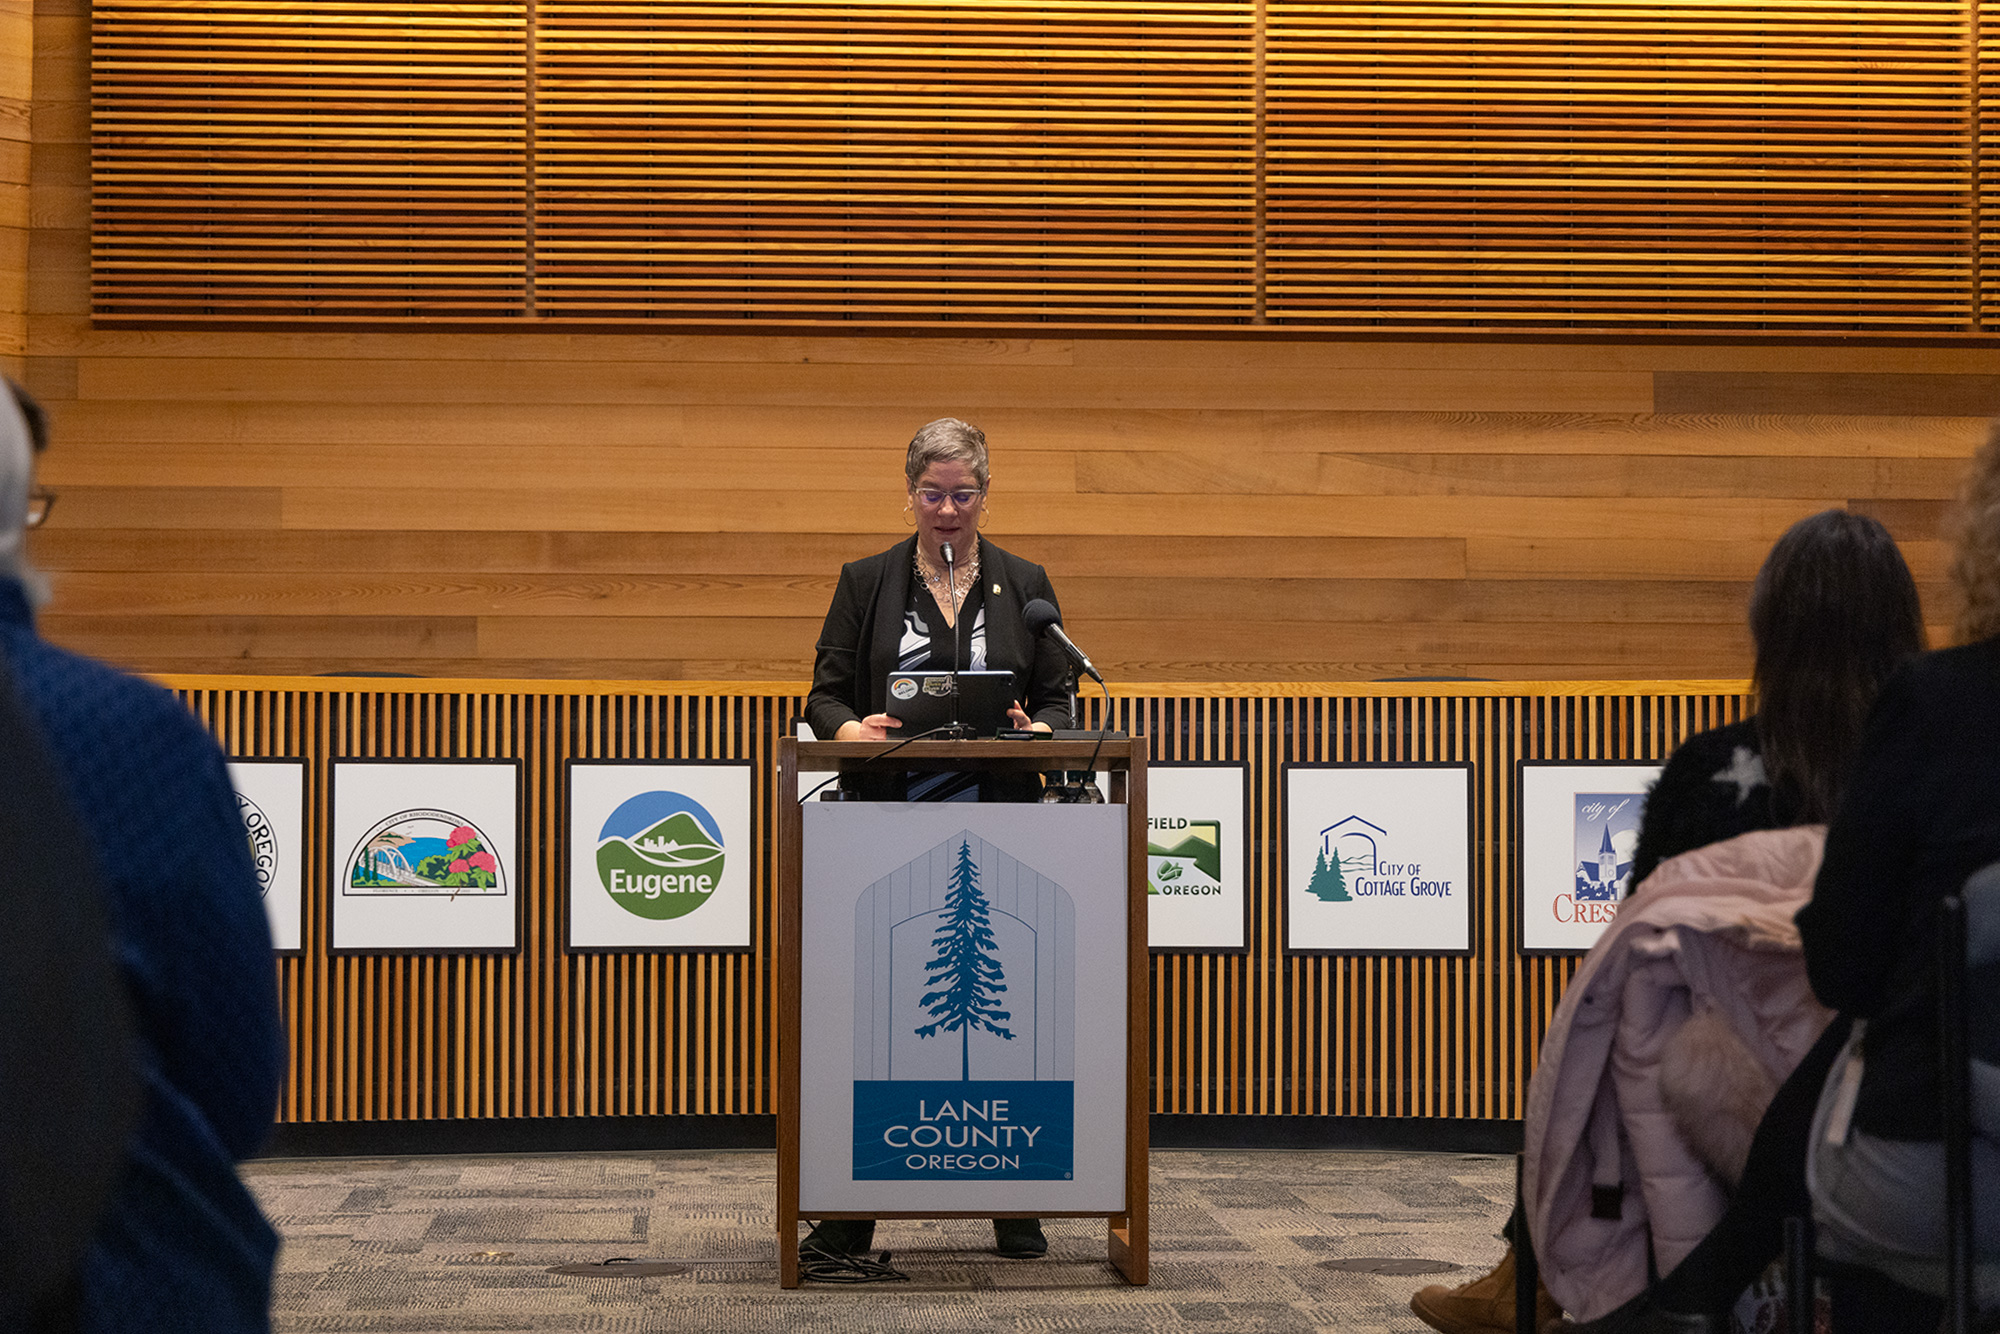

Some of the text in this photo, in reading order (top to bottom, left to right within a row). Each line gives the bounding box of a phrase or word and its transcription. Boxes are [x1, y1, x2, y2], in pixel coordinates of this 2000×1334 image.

[1581, 799, 1630, 821] city of
[246, 813, 273, 891] OREGO
[610, 869, 712, 899] Eugene
[1162, 885, 1221, 896] OREGON
[1553, 893, 1620, 924] CRES
[919, 1100, 1009, 1121] LANE
[883, 1125, 1042, 1148] COUNTY
[905, 1154, 1020, 1170] OREGON
